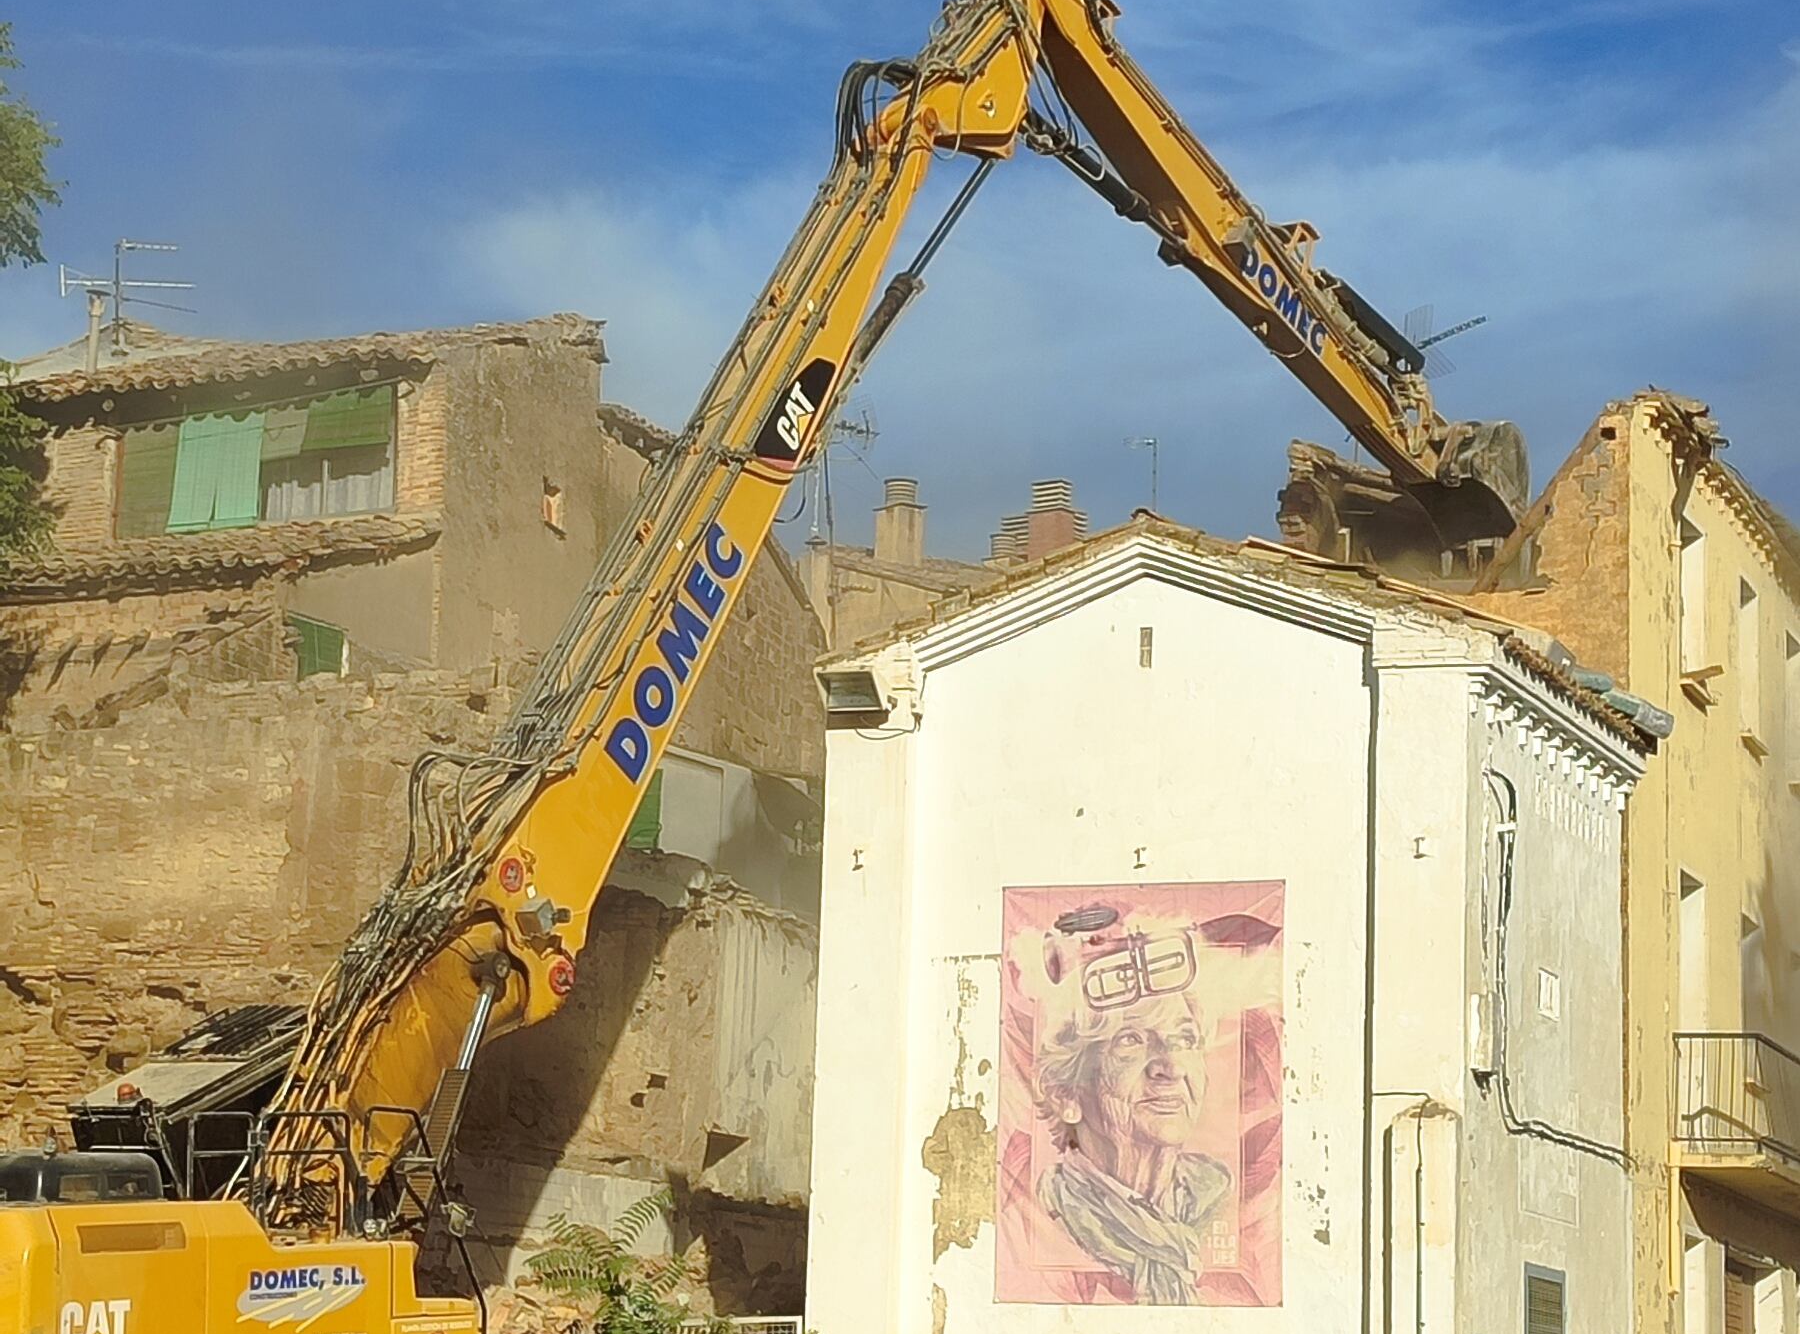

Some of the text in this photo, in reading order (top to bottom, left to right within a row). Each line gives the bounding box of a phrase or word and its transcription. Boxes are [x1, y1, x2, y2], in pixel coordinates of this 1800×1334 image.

[775, 381, 815, 452] CAT
[603, 522, 743, 785] DOMEC
[249, 1265, 366, 1291] DOMEC, S.L.
